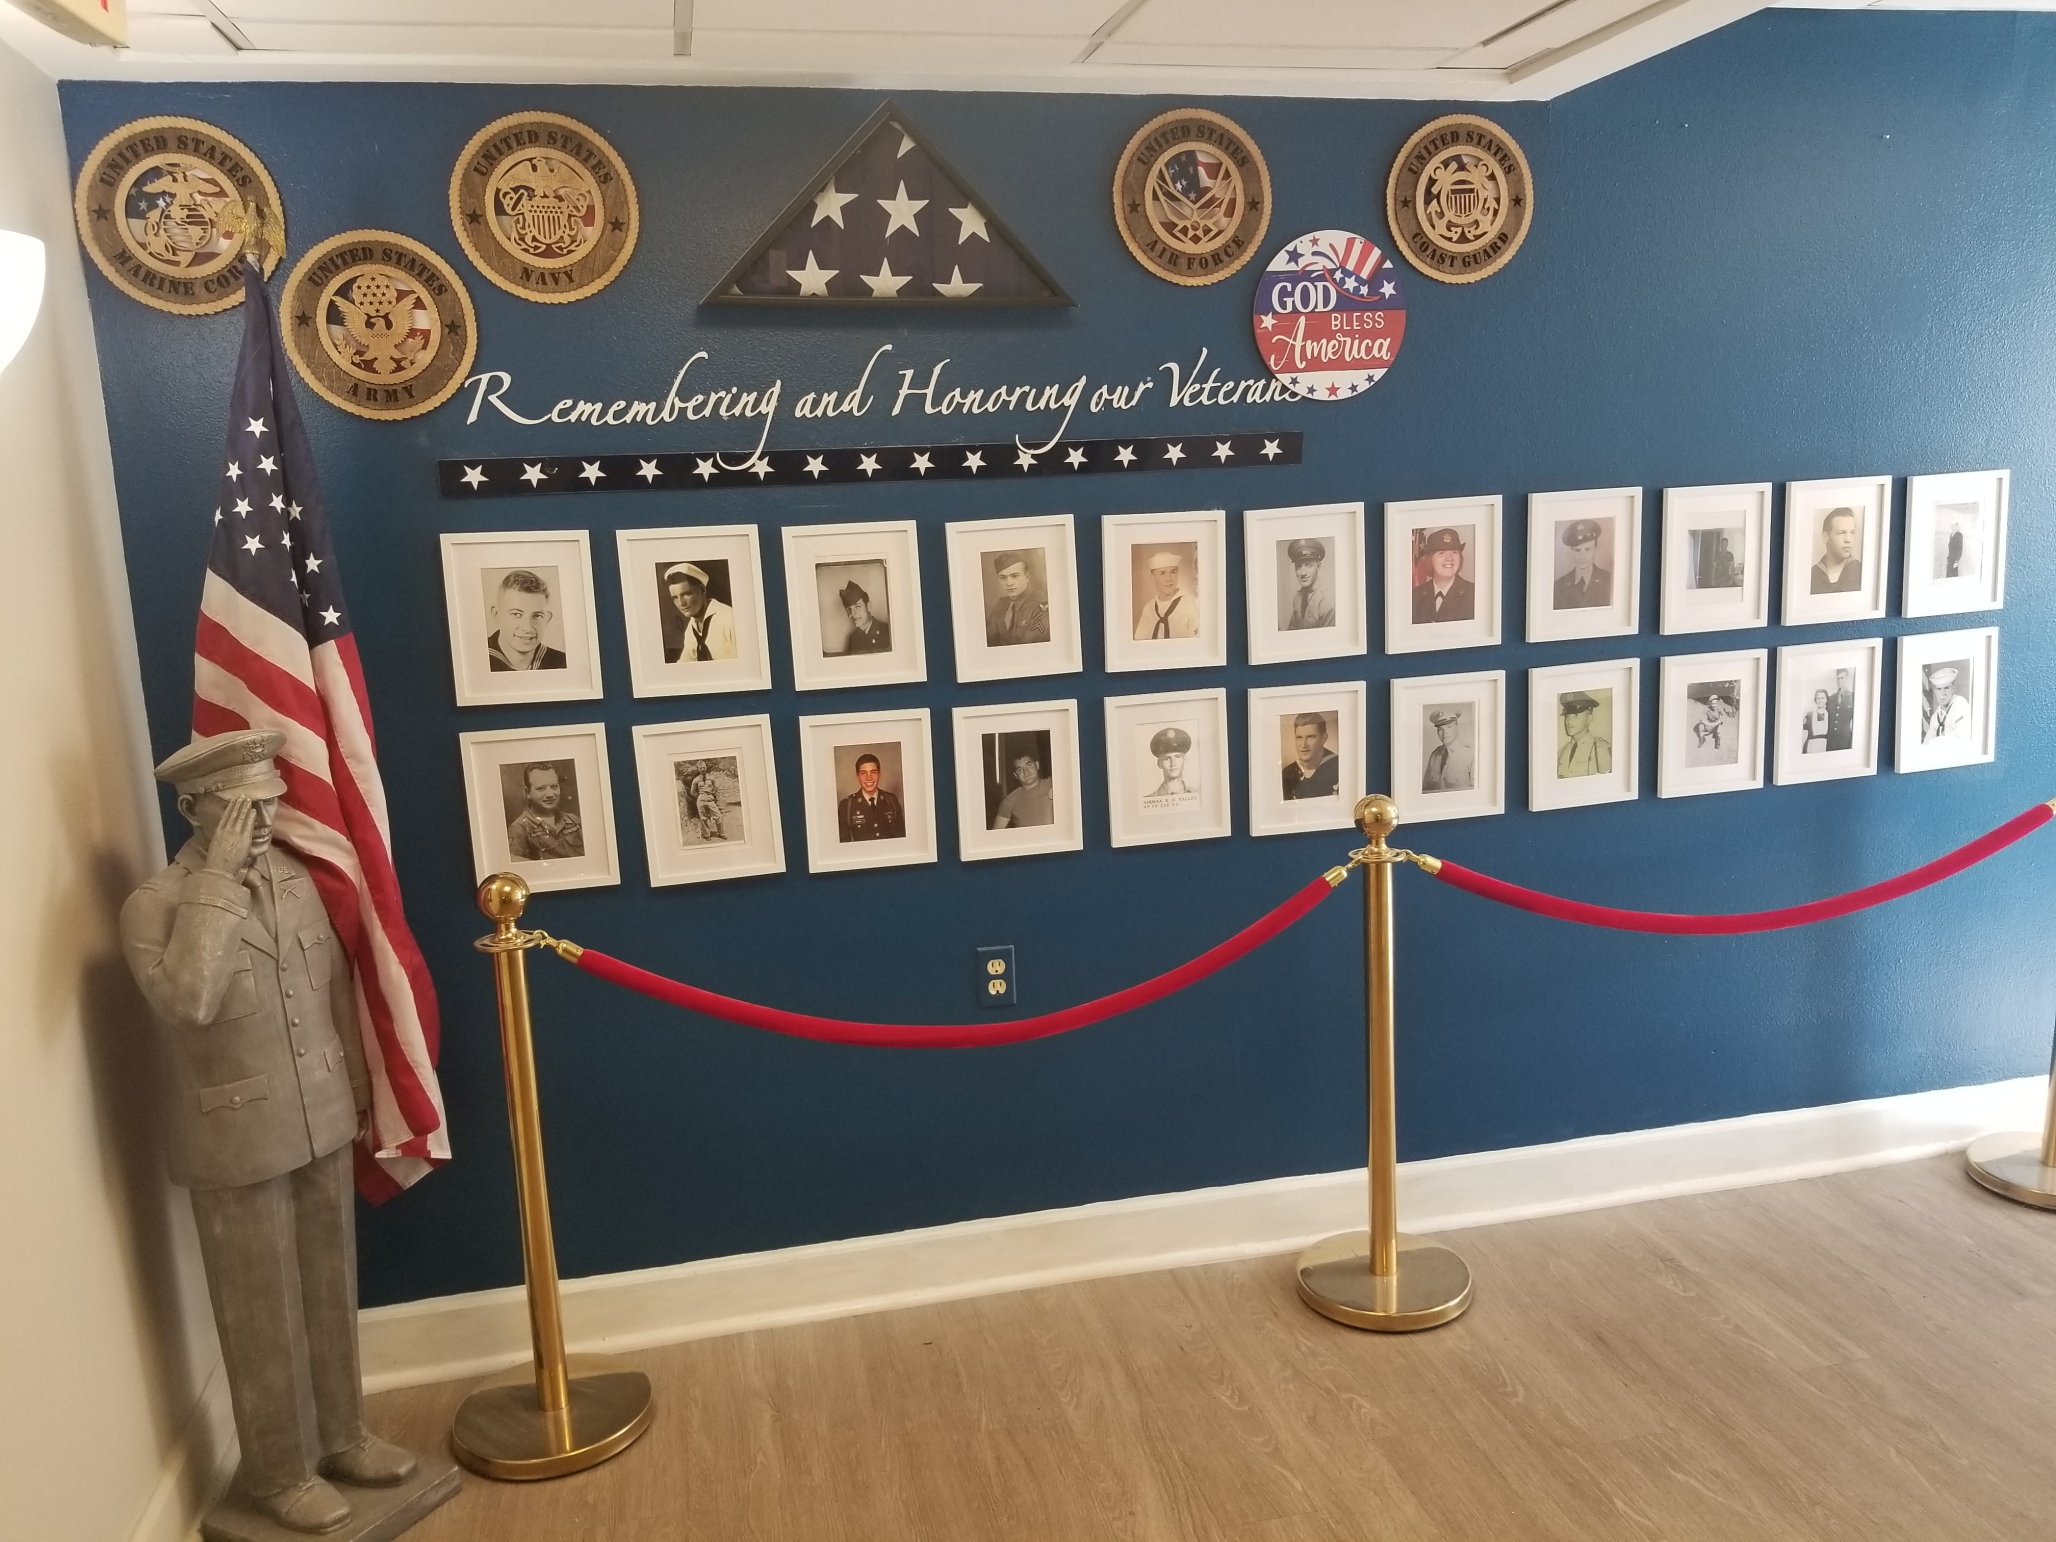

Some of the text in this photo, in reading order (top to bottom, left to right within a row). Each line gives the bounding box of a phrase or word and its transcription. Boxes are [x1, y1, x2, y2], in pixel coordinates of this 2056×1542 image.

[100, 135, 252, 187] UNITED STATES
[473, 130, 614, 185] UNITED STATES
[1137, 125, 1249, 168] UNITED STATES
[1408, 130, 1516, 176] UNITED STATES
[308, 246, 447, 296] UNITED STATES
[1146, 236, 1245, 269] AIR FORCE
[1411, 231, 1509, 268] COAST GUARD
[113, 248, 195, 296] MARINE
[519, 266, 576, 286] NAVY
[1271, 281, 1337, 313] GOD
[1270, 315, 1391, 370] America
[1331, 312, 1385, 330] BLESS
[346, 382, 416, 402] ARMY
[464, 351, 781, 470] Remembering
[794, 344, 893, 418] and
[891, 359, 1087, 455] Honoring
[1089, 376, 1153, 413] our
